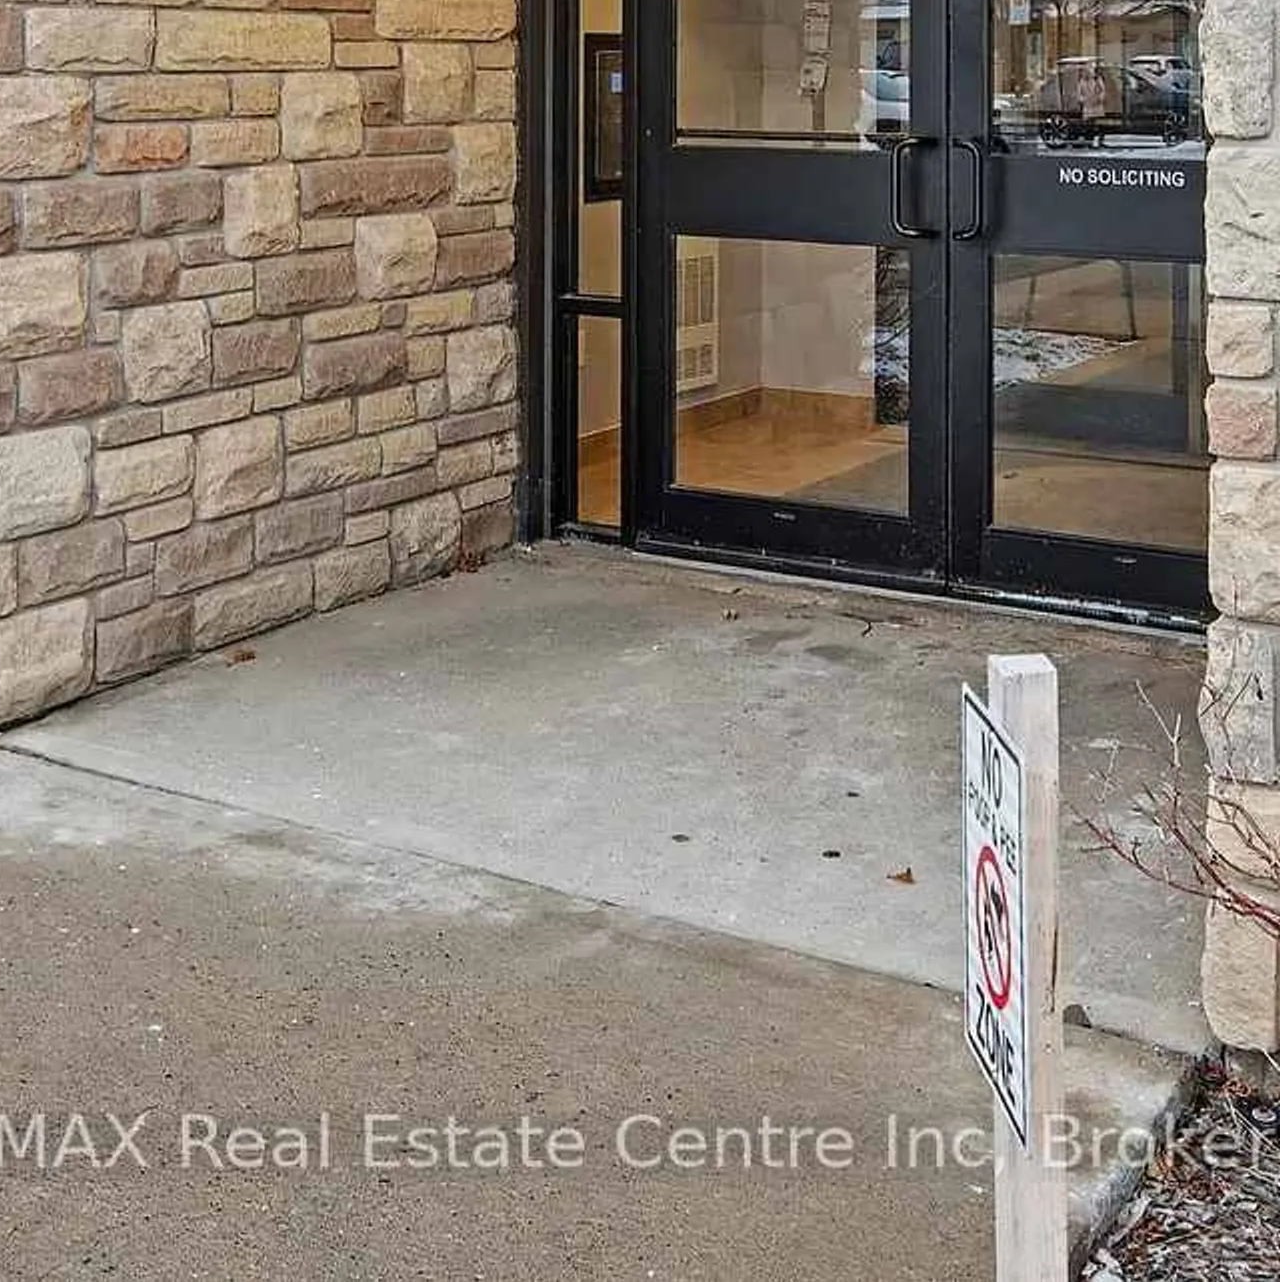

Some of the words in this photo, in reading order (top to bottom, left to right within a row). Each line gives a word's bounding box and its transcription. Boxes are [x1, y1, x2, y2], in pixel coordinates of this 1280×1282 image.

[1059, 168, 1084, 184] NO
[1088, 168, 1186, 188] SOLICITING
[981, 730, 1002, 809] NO
[976, 983, 1016, 1107] ZONE
